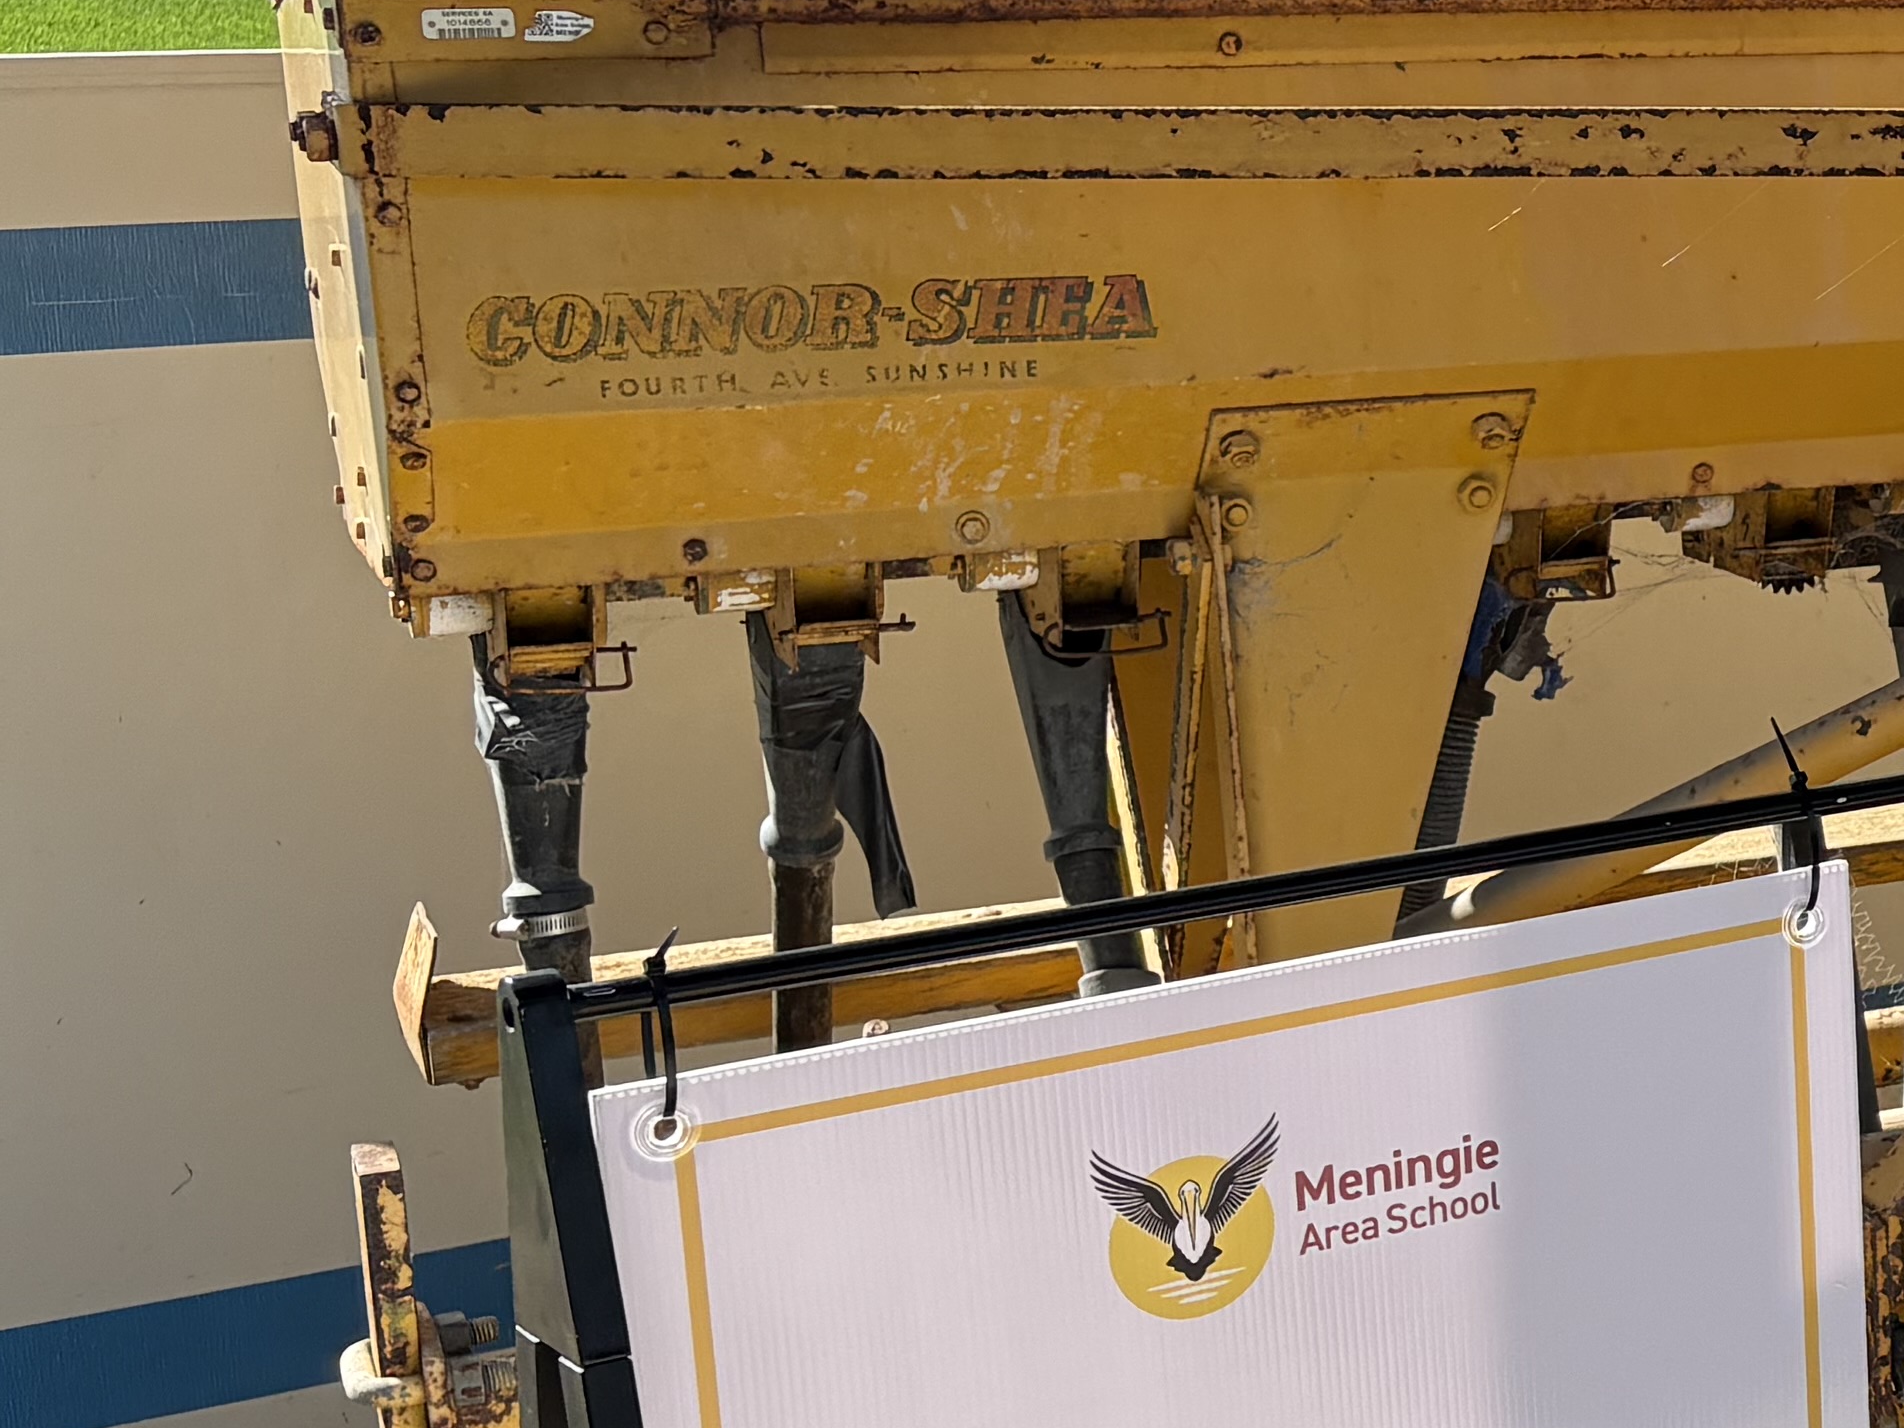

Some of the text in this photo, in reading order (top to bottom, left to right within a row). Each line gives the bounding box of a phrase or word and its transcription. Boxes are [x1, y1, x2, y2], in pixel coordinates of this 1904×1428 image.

[467, 274, 1158, 367] CONNOR-SHEA
[866, 358, 1040, 384] SUNSHINE
[1295, 1134, 1499, 1212] Meningie
[1299, 1180, 1501, 1256] Area School
